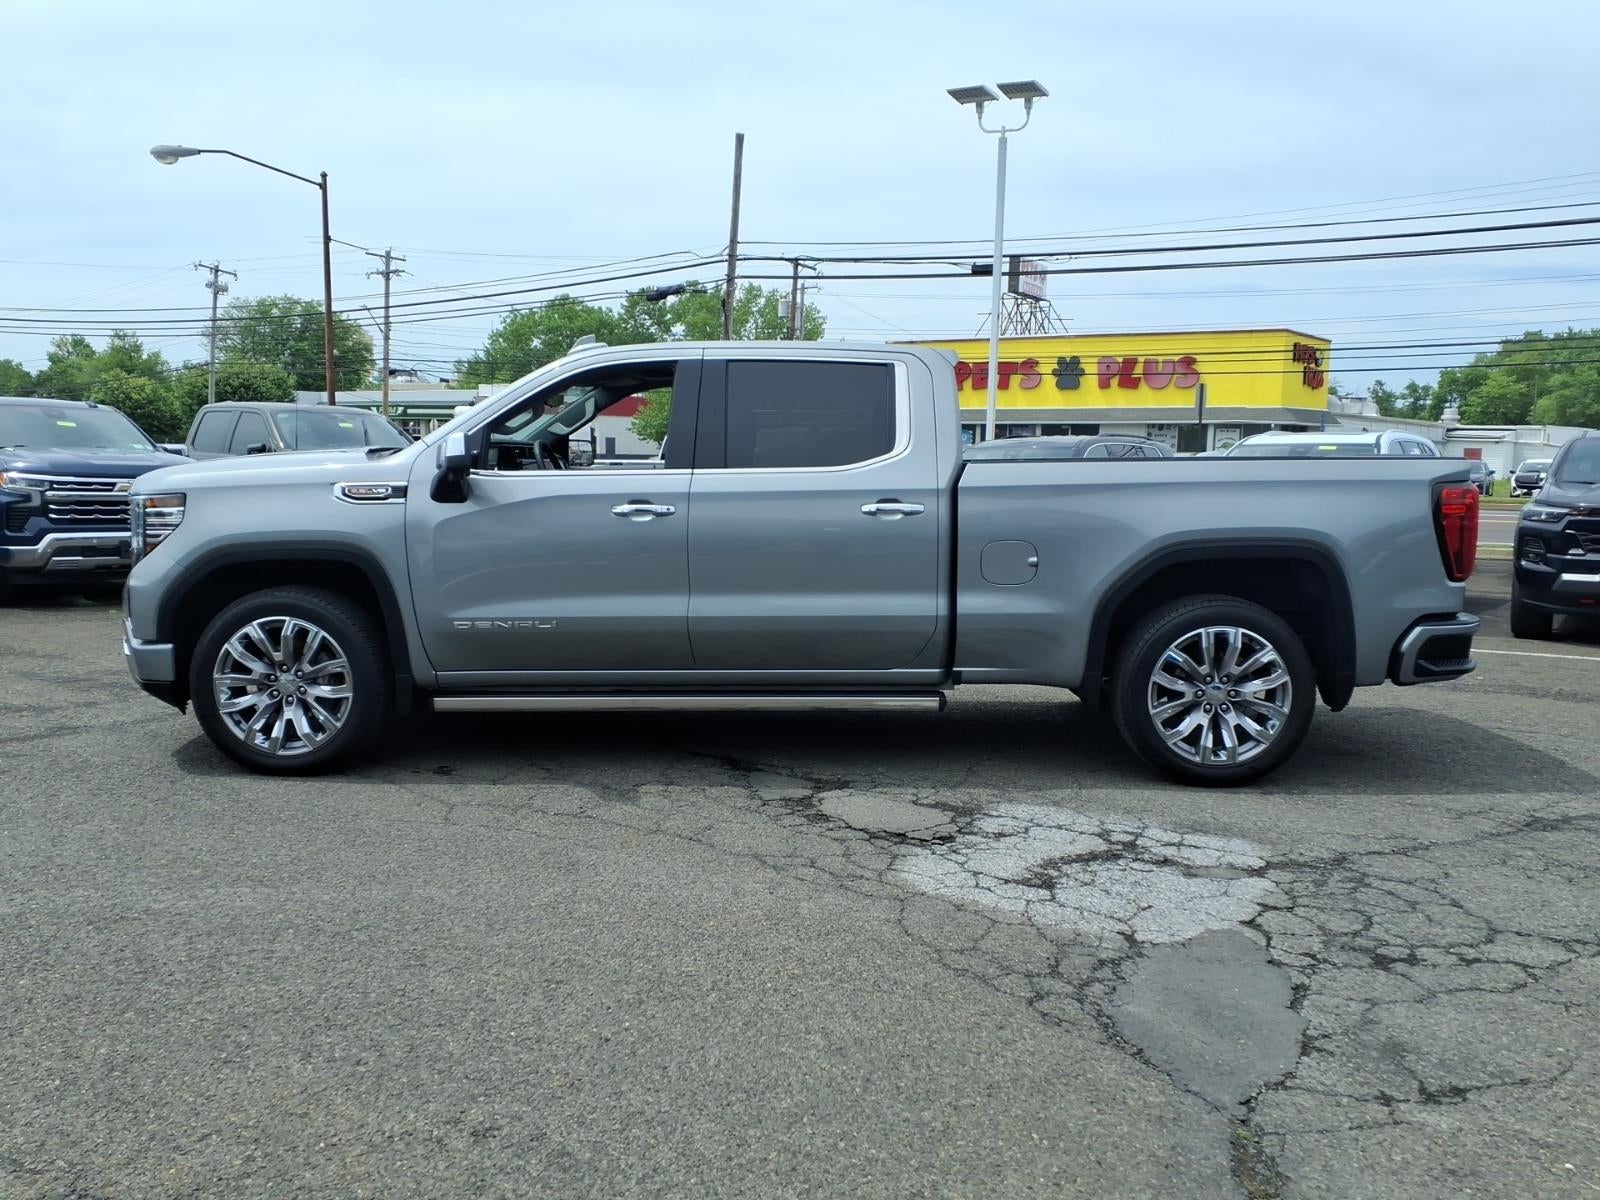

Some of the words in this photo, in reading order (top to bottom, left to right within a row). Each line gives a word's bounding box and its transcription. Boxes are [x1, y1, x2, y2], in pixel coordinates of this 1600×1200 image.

[955, 358, 1042, 390] PETS
[1097, 356, 1201, 389] PLUS
[453, 620, 557, 629] DENALI
